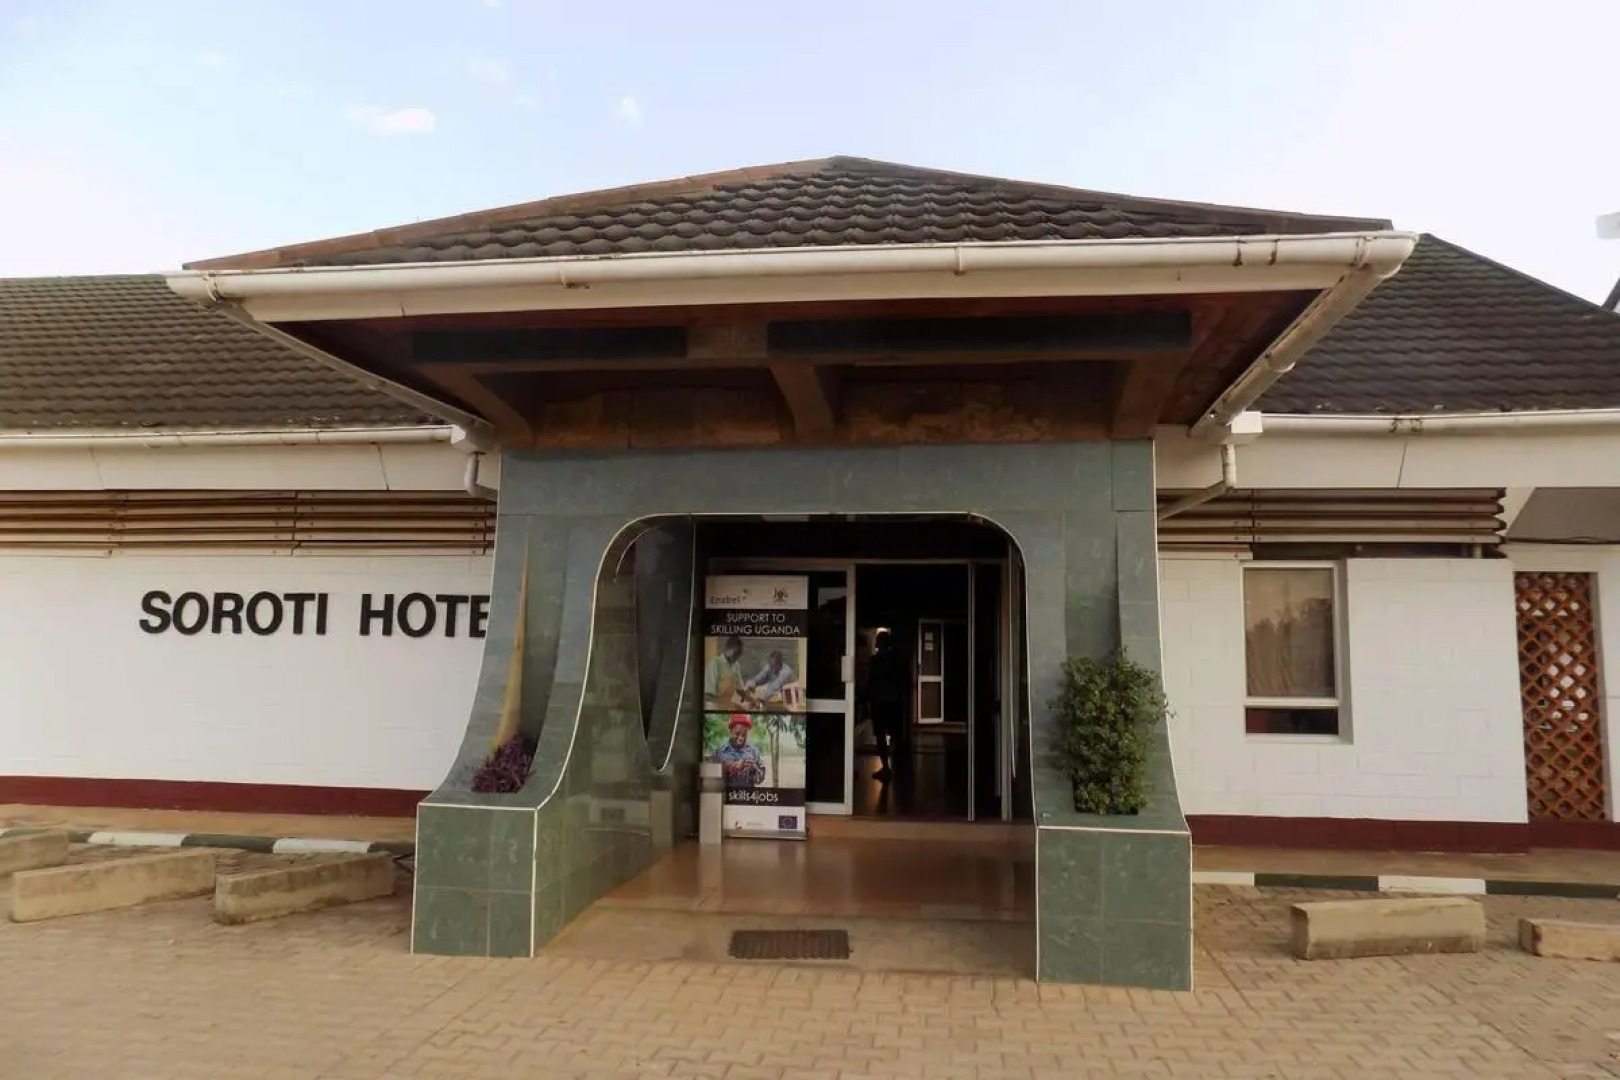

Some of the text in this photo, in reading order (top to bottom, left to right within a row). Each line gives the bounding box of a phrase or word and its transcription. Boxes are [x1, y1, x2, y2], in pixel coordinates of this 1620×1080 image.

[139, 591, 329, 636] SOROTI
[726, 613, 785, 623] SUPPORT TO
[710, 624, 800, 635] SKILLING UGANDA
[728, 790, 779, 803] skills4jobs
